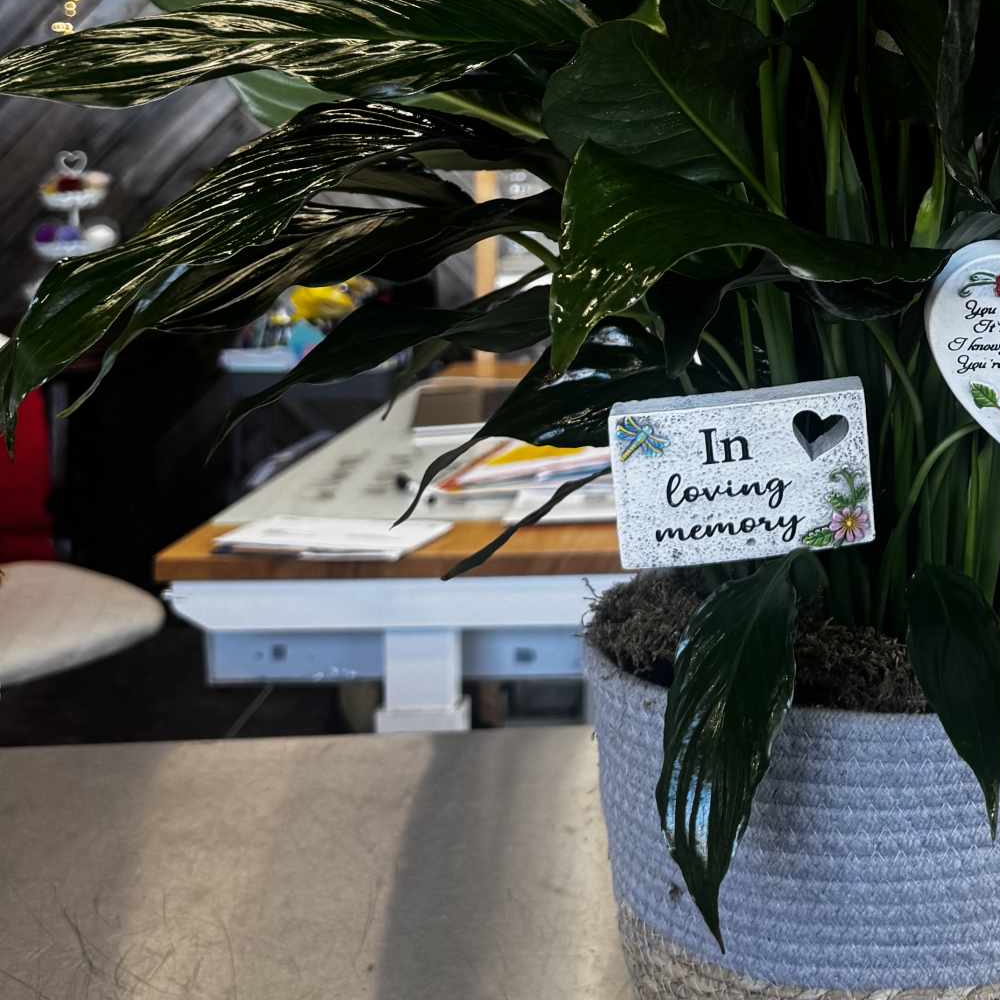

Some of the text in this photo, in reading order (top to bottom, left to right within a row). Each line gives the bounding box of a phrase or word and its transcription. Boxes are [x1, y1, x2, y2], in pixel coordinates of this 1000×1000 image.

[964, 299, 997, 319] You
[948, 337, 968, 351] I
[968, 337, 1000, 351] know
[699, 427, 753, 465] In
[666, 473, 792, 509] loving
[655, 512, 805, 543] memory
